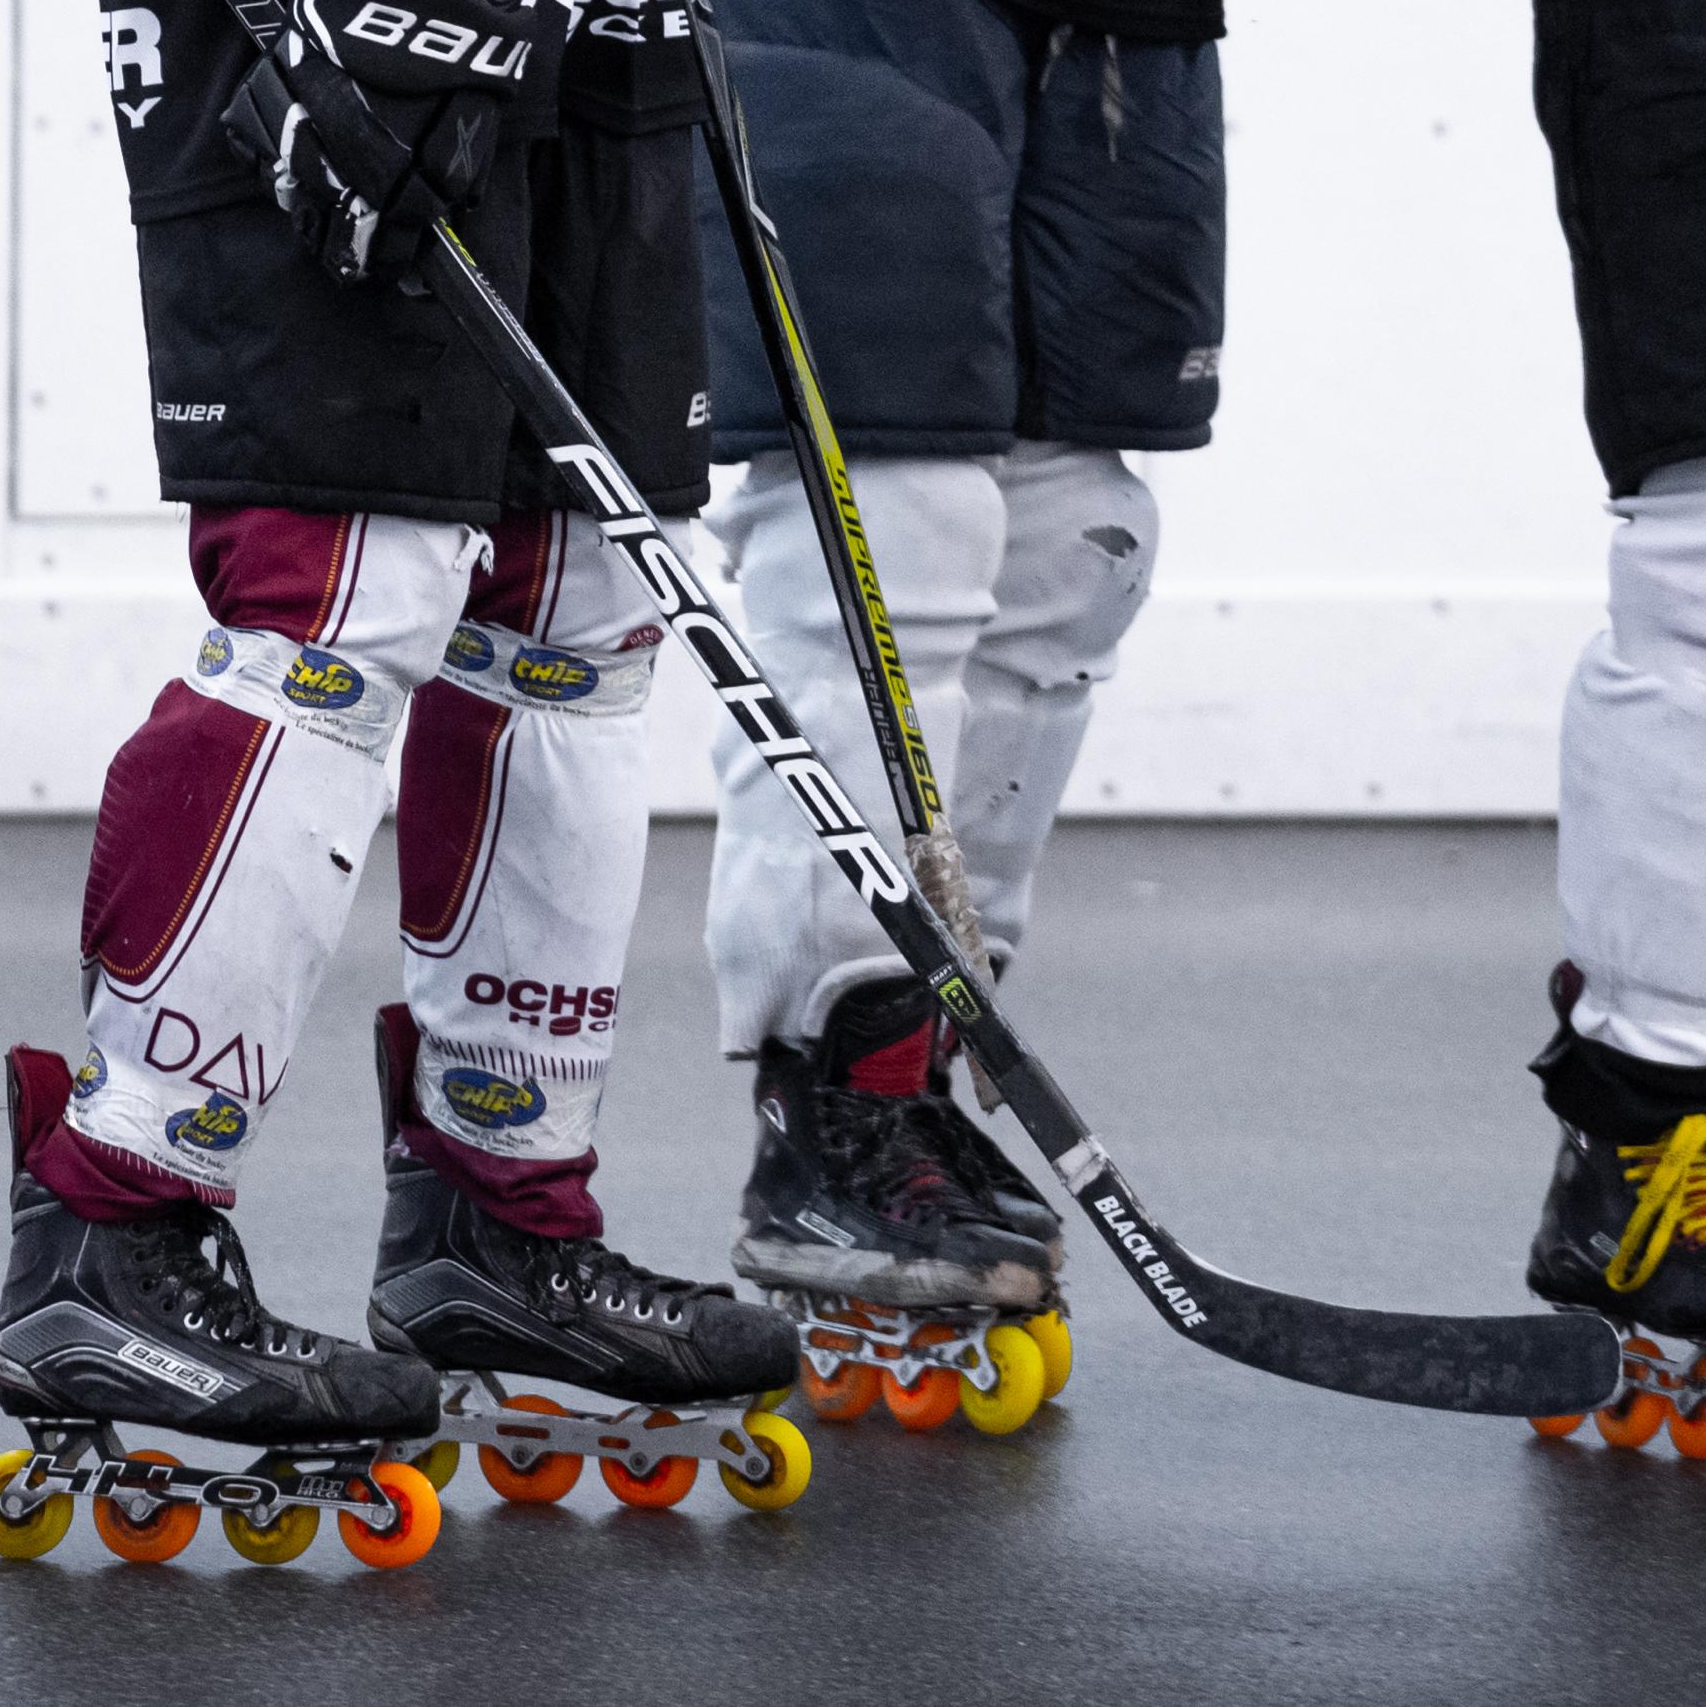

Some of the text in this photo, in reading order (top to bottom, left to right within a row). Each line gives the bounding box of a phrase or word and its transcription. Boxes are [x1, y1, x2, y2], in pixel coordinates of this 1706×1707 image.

[343, 1, 532, 81] BAU
[827, 458, 914, 707] SUPREME
[546, 442, 910, 909] FISCHER
[464, 972, 620, 1018] OCHS
[143, 1006, 290, 1106] DAV
[1094, 1195, 1210, 1329] BLACK BLADE
